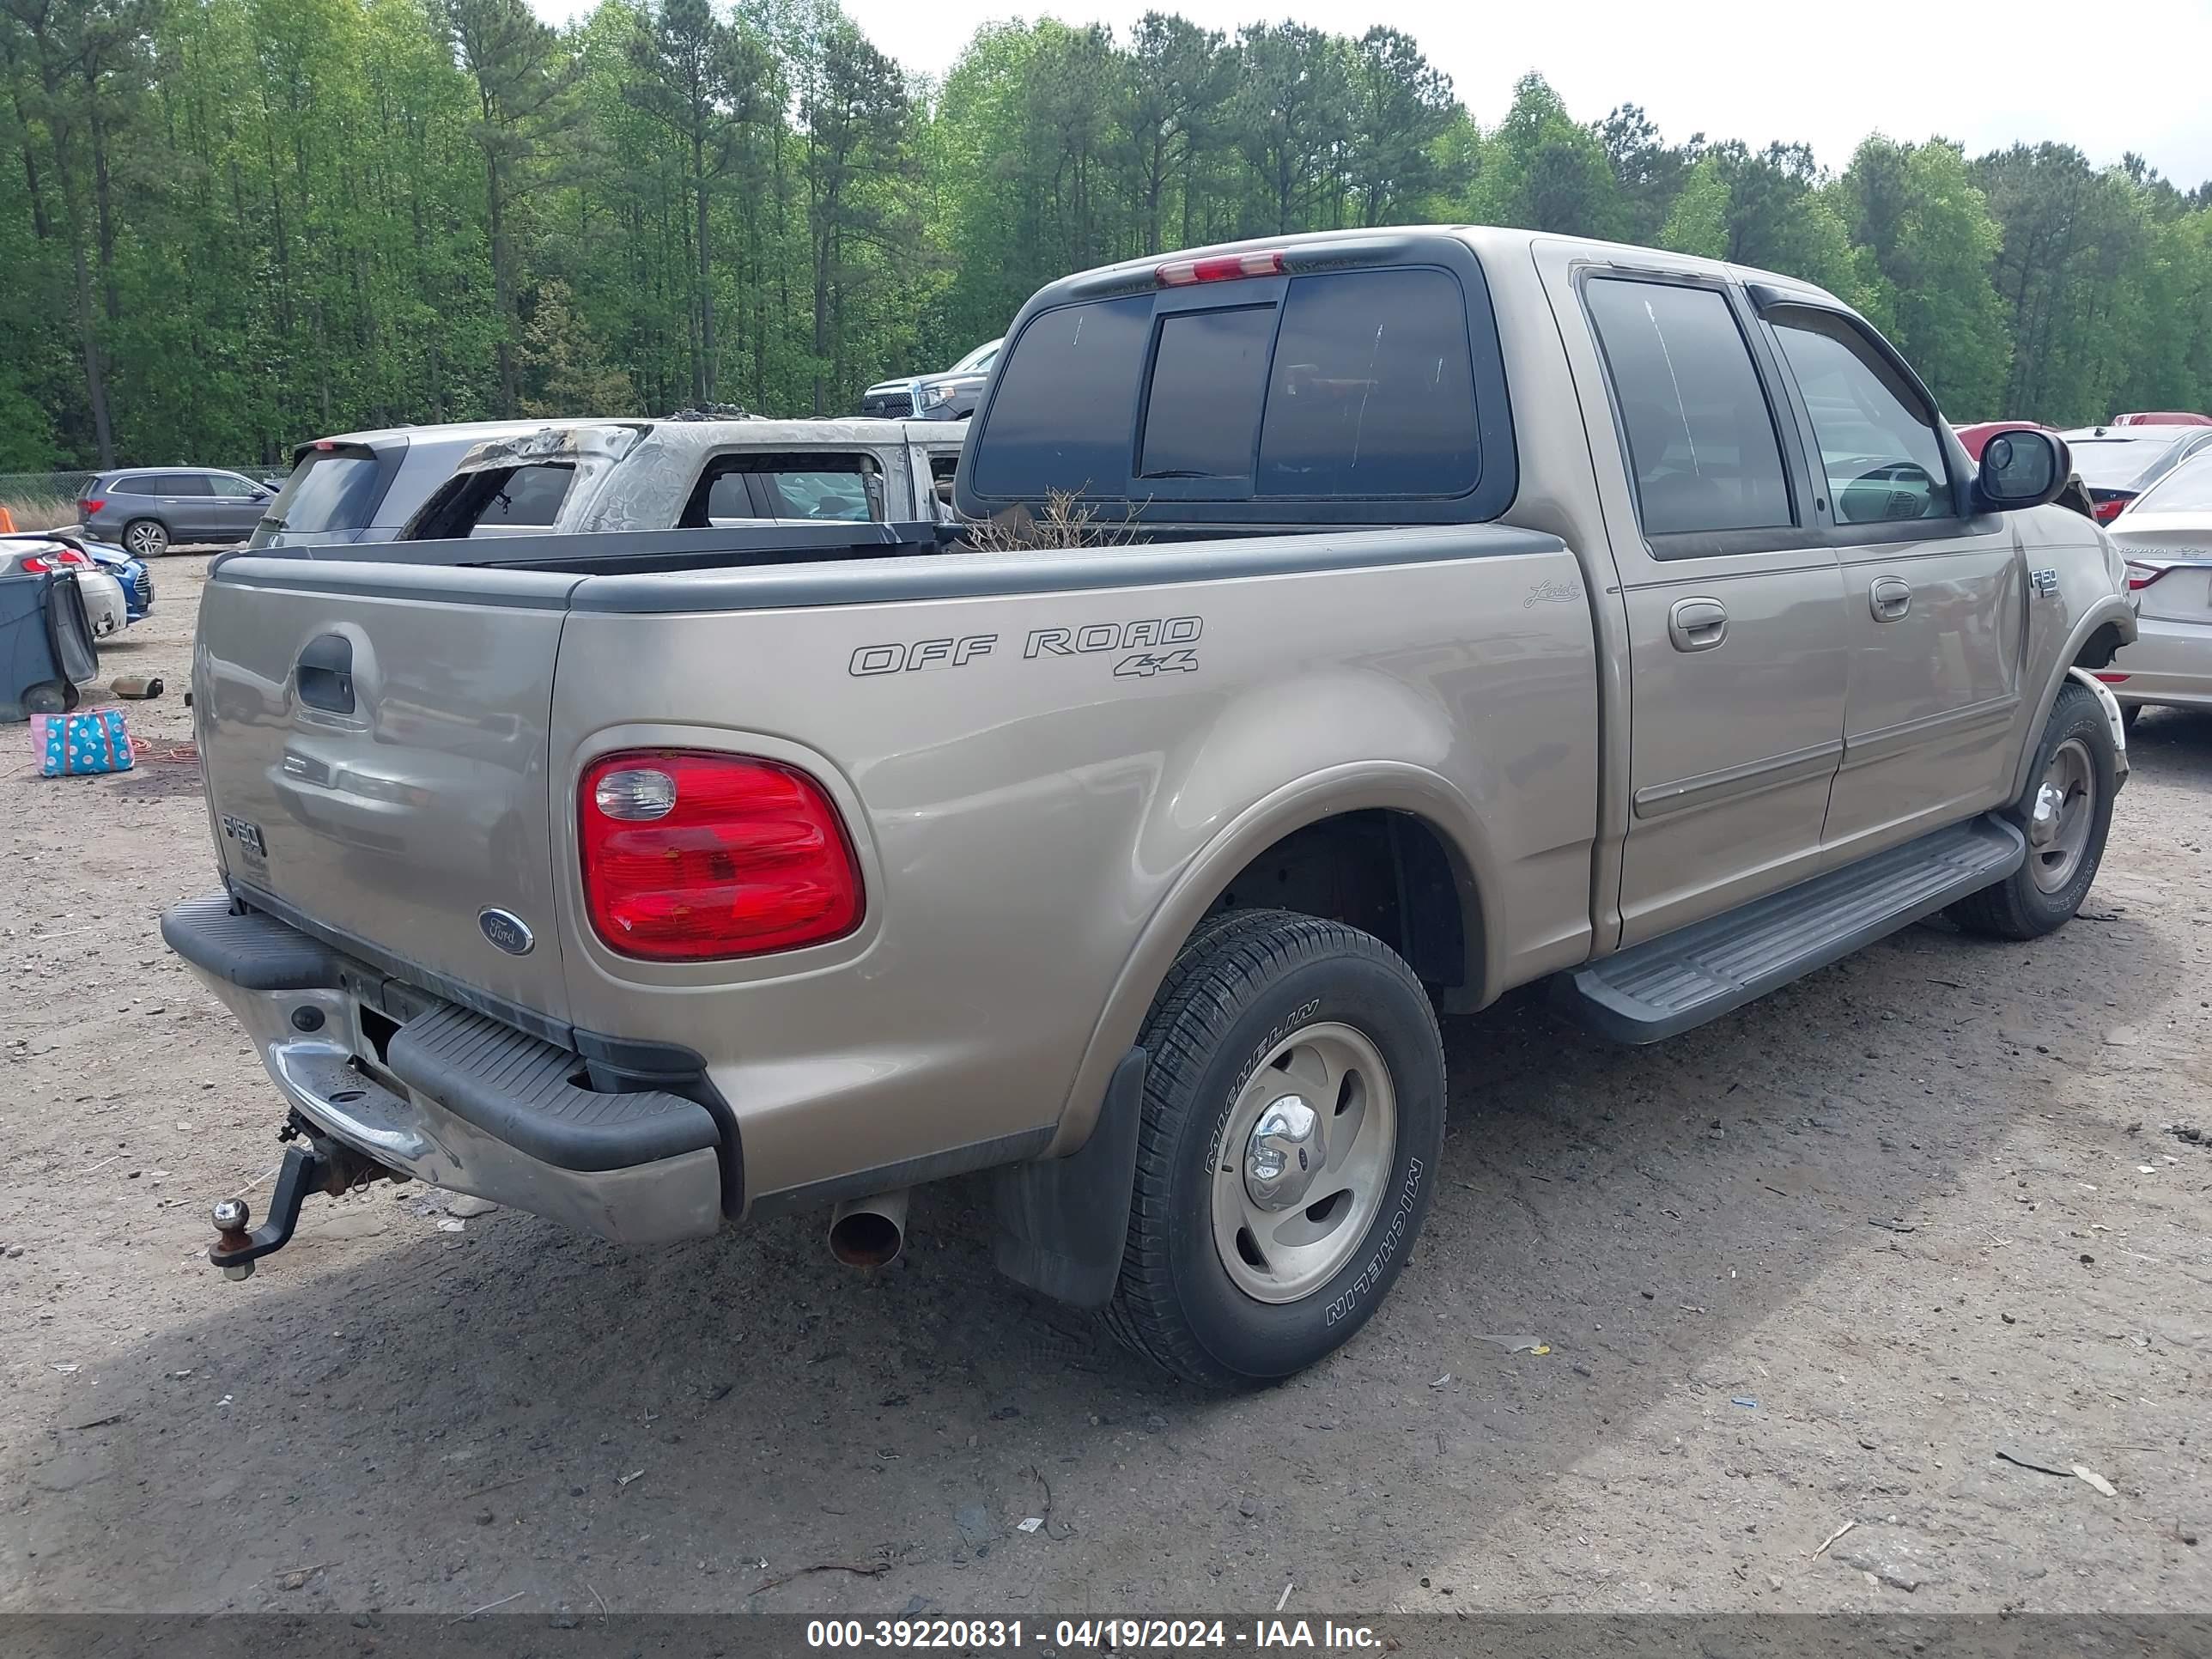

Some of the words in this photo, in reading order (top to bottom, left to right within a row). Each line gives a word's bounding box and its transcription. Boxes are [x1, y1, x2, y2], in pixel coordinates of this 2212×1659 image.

[848, 634, 998, 677] OFF
[1024, 616, 1203, 659] ROAD
[489, 917, 516, 945] Ford
[1204, 999, 1320, 1175] MICHELIN
[1326, 1157, 1424, 1327] MICHELIN
